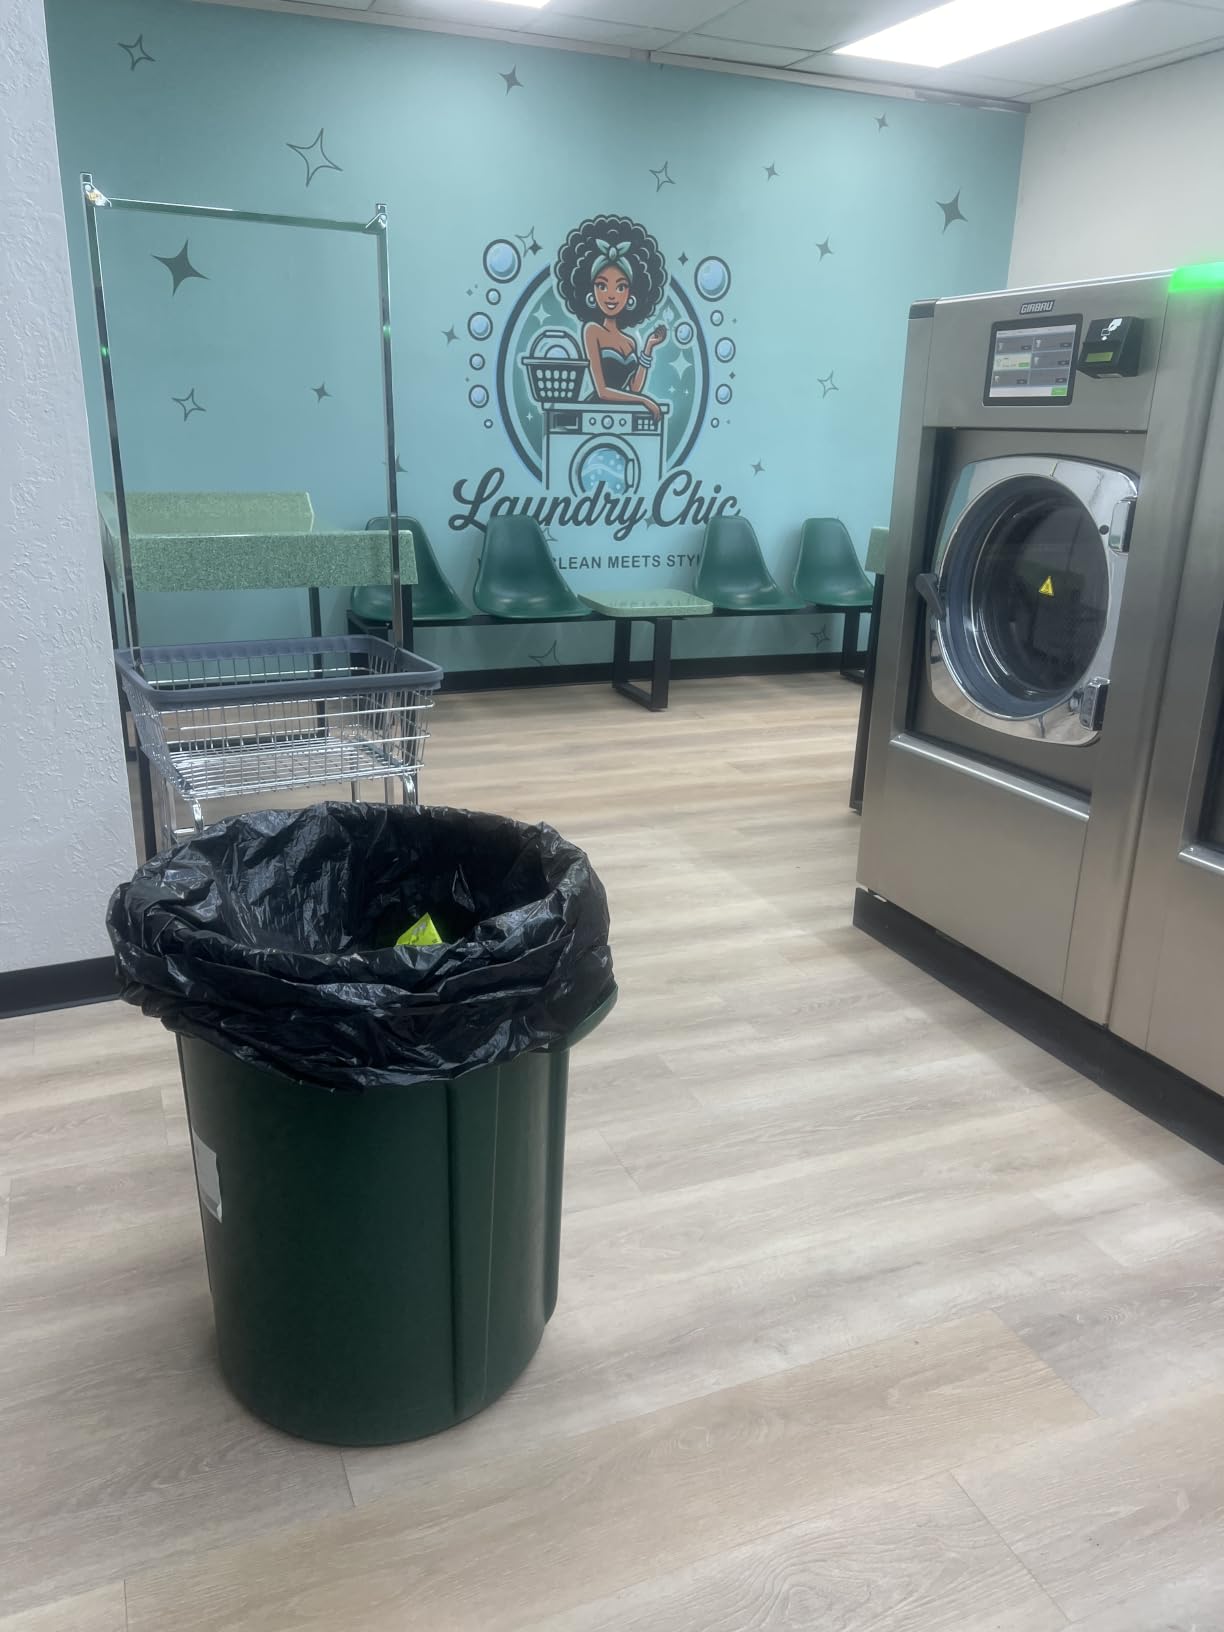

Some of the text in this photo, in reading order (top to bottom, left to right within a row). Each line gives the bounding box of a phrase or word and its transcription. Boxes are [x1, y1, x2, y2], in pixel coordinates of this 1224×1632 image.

[1020, 301, 1054, 314] GIRBAU
[448, 467, 741, 541] Laundry Chic
[552, 556, 602, 570] LEAN
[607, 555, 661, 569] MEETS
